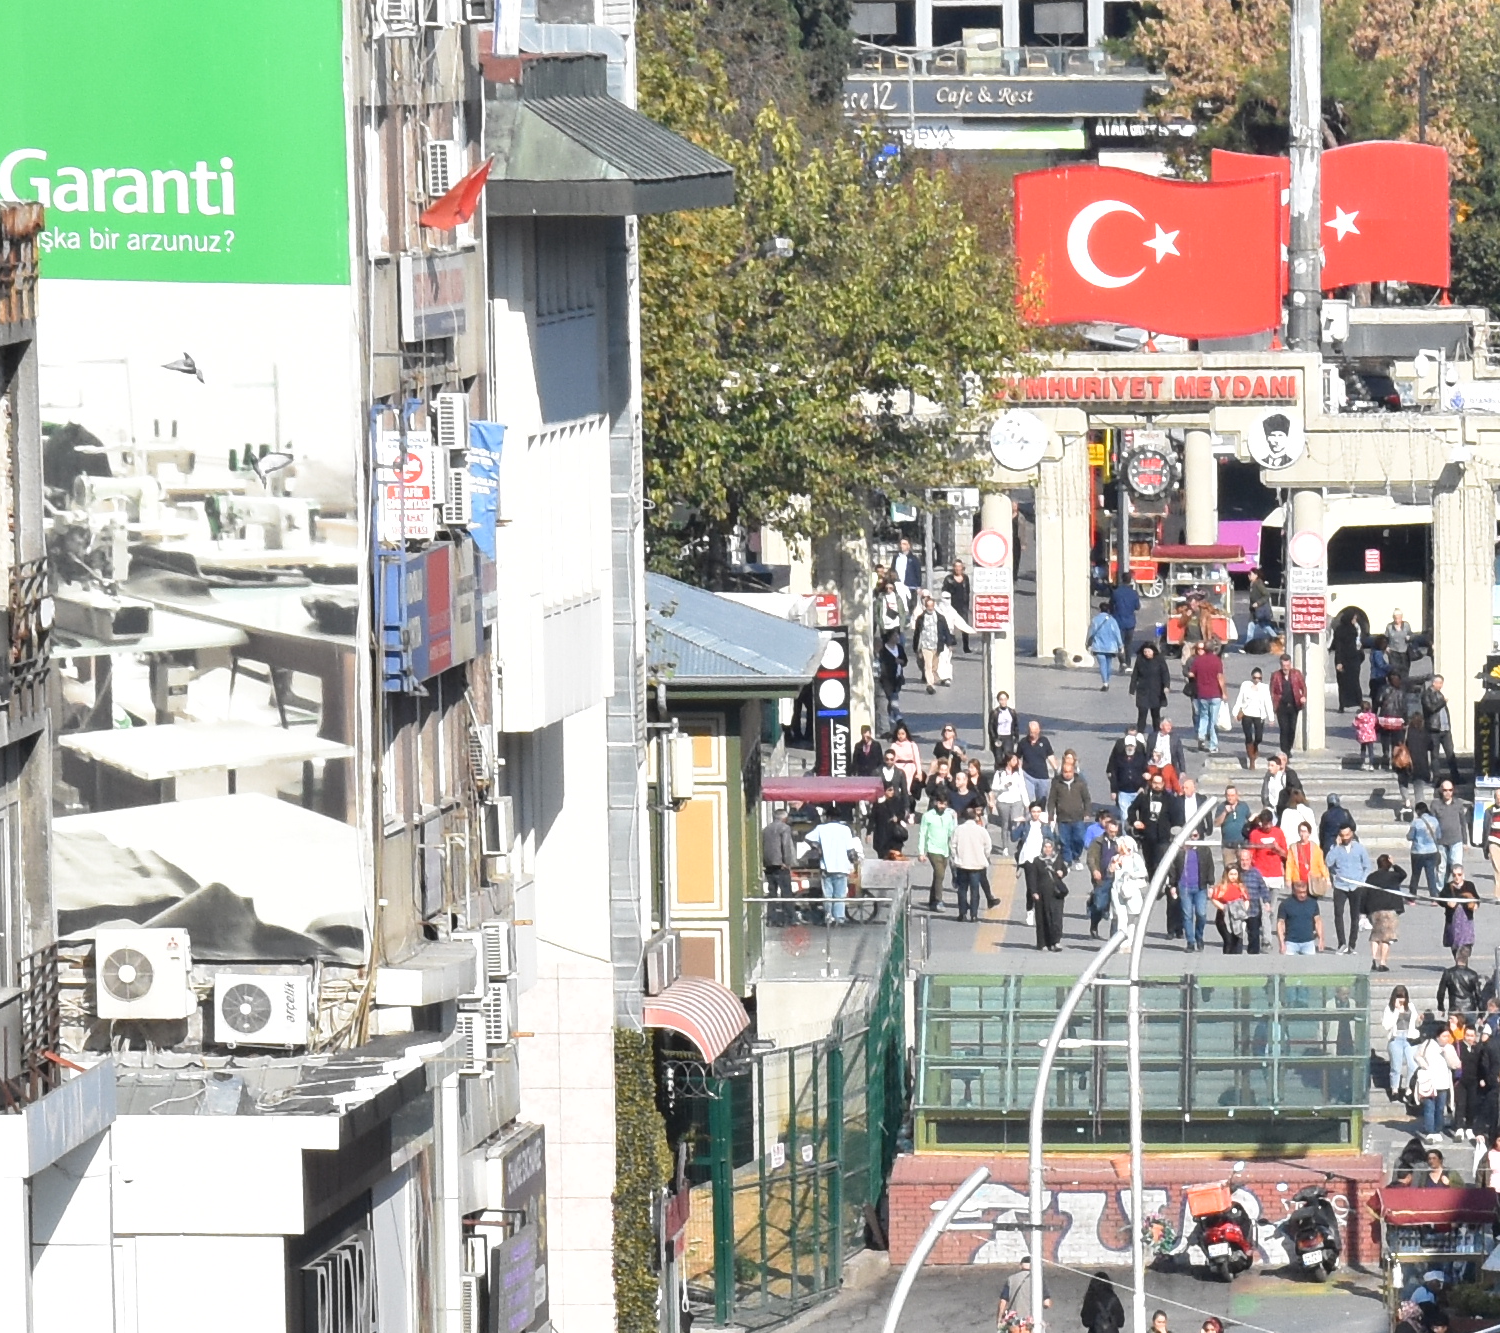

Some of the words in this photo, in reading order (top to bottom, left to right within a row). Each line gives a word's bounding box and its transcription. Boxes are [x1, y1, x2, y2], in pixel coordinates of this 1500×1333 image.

[936, 86, 973, 106] Cafe
[977, 87, 993, 103] &
[998, 87, 1034, 104] Rest
[37, 228, 81, 252] şka
[88, 227, 120, 251] bir
[127, 230, 236, 253] arzunuz?
[1174, 376, 1296, 399] MEYDANI
[283, 981, 298, 1023] arçelik
